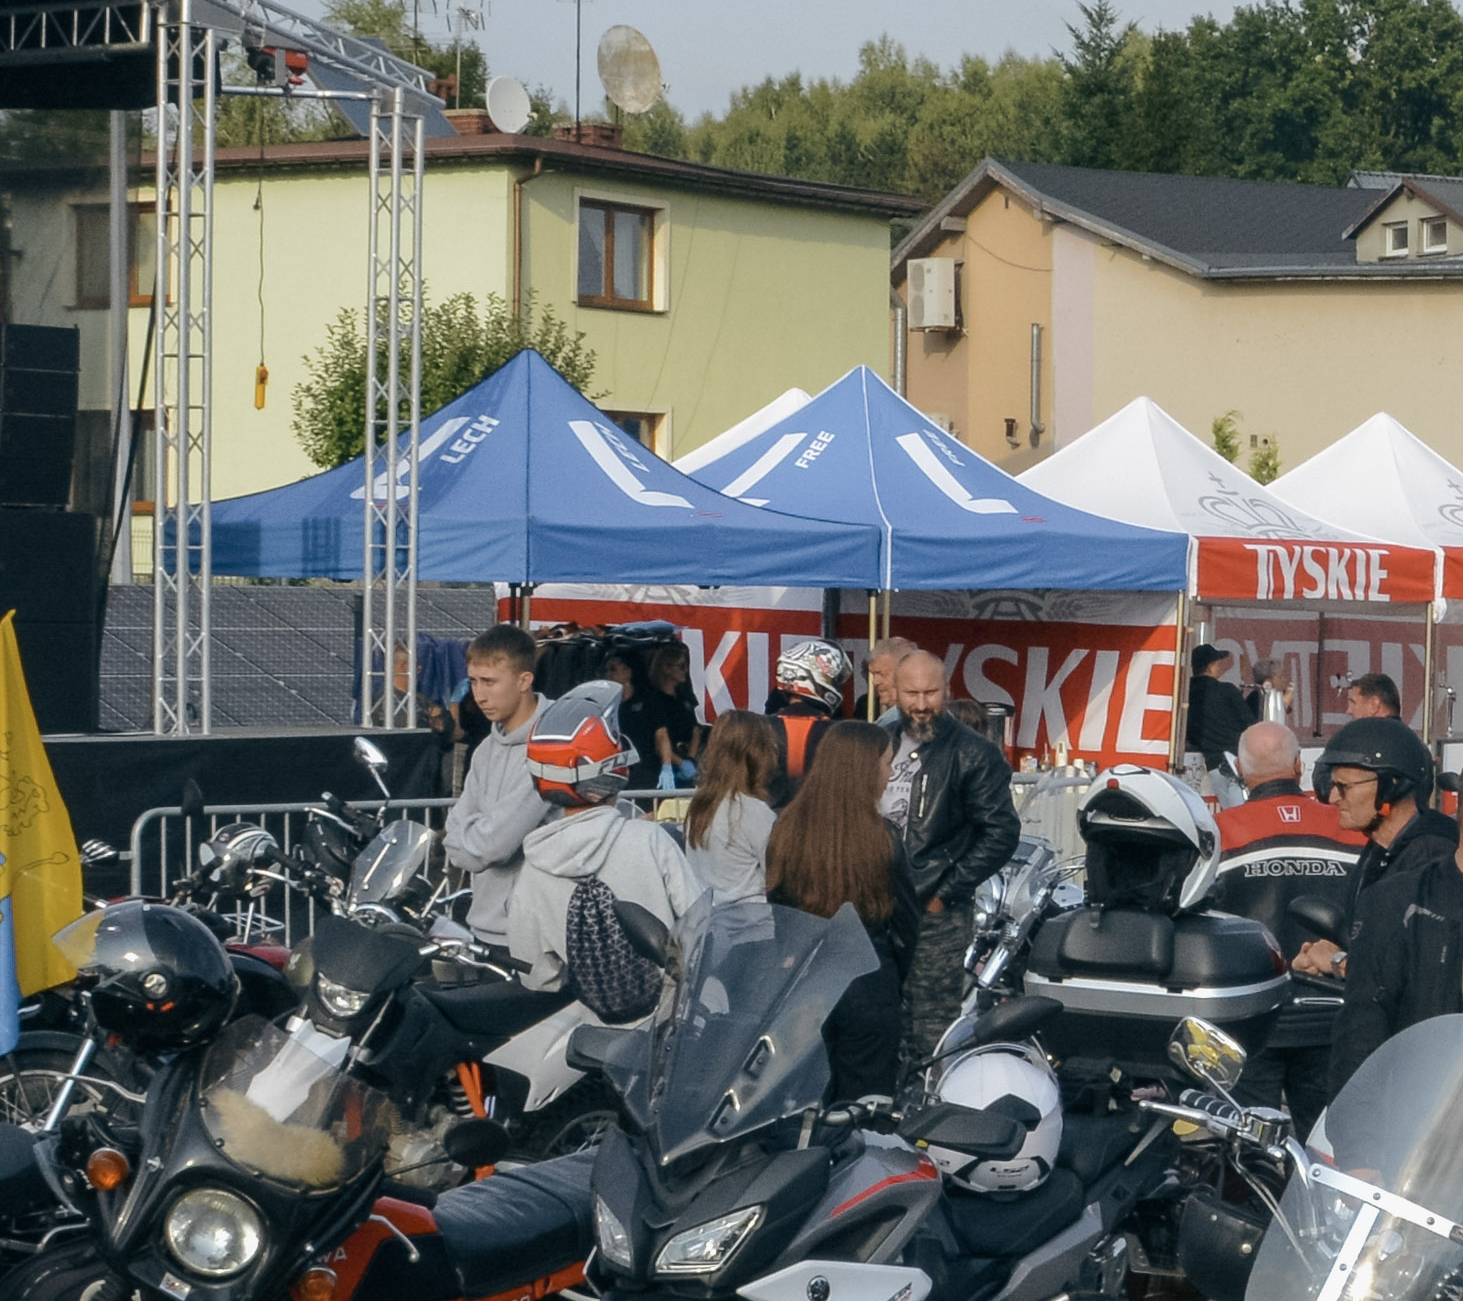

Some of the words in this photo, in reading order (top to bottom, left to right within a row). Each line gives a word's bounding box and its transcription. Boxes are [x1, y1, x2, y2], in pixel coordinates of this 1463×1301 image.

[440, 415, 500, 463] LECH
[795, 431, 835, 469] FREE
[1244, 544, 1390, 600] TYSKIE
[1244, 860, 1347, 877] HONDA
